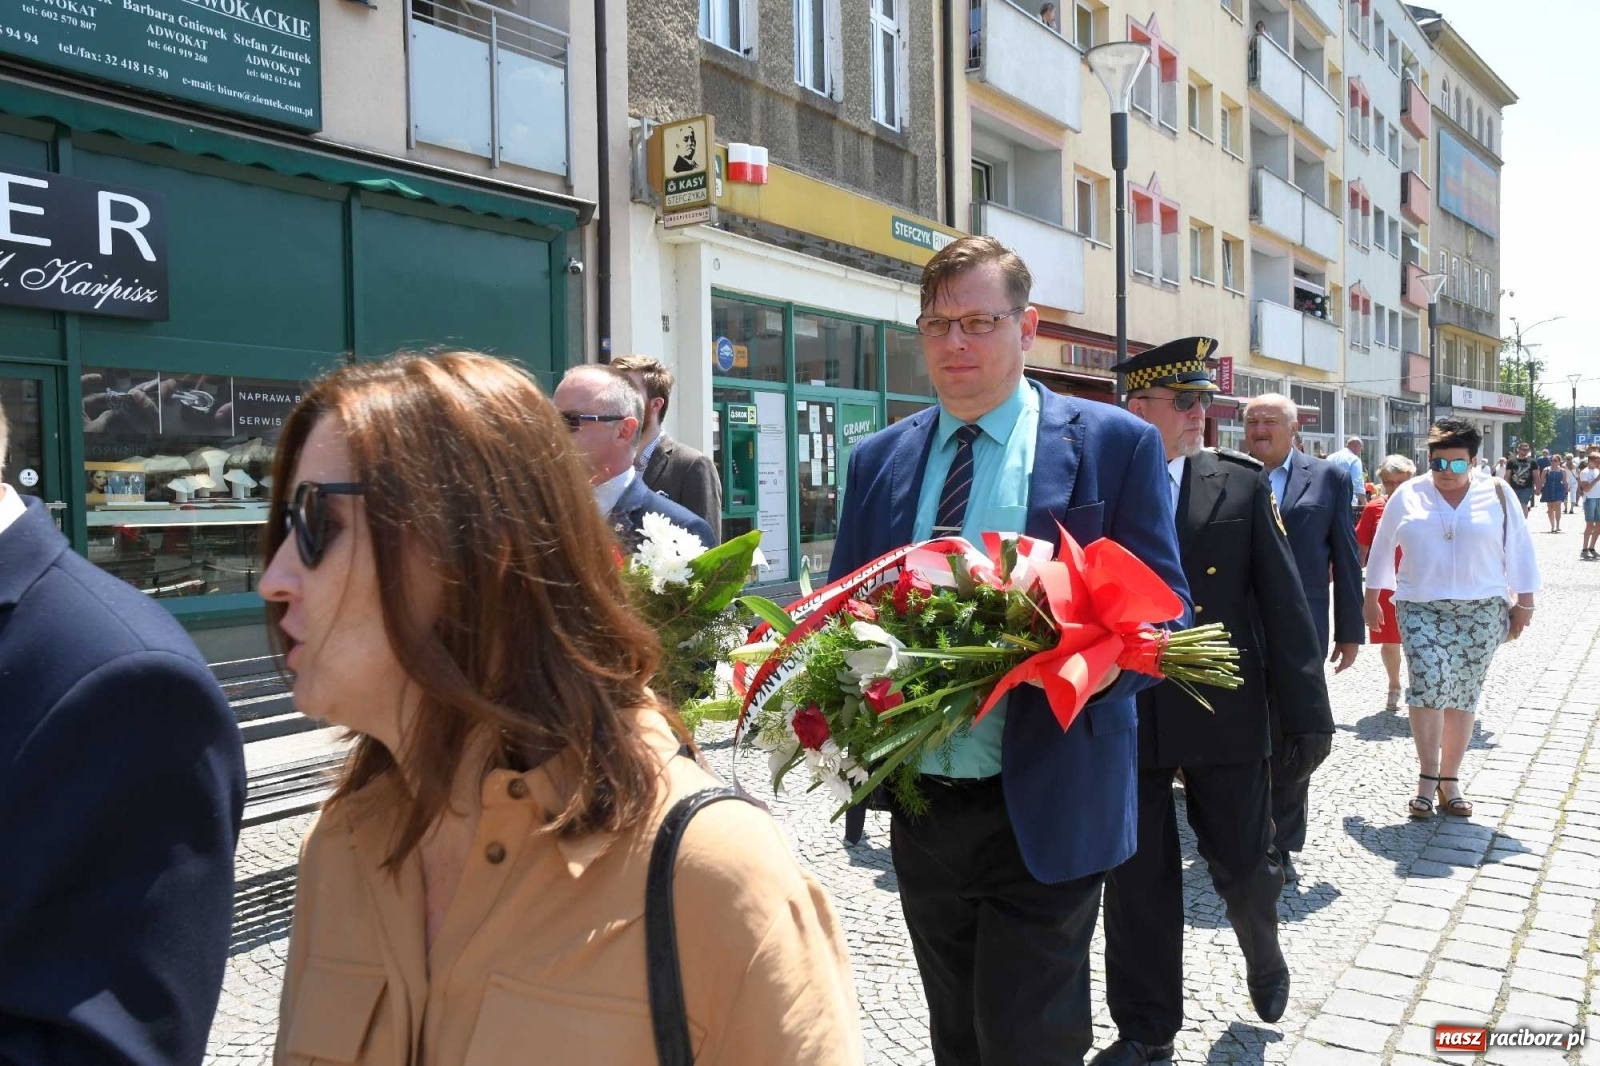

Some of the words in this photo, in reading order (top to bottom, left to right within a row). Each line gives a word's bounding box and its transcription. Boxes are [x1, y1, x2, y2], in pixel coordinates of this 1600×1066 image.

[22, 4, 38, 15] tel:
[41, 9, 58, 21] 602
[60, 14, 78, 27] 570
[80, 20, 97, 31] 807
[122, 0, 174, 23] Barbara
[178, 15, 227, 40] Gniewek
[190, 0, 311, 38] WOKACKIE
[5, 26, 21, 40] 94
[24, 31, 39, 45] 94
[146, 23, 208, 51] ADWOKAT
[58, 42, 102, 62] tel./fax:
[104, 53, 119, 66] 32
[120, 59, 140, 72] 418
[143, 64, 155, 75] 15
[156, 68, 169, 79] 30
[147, 39, 161, 50] tel:
[162, 43, 177, 54] 661
[178, 47, 193, 58] 919
[194, 52, 209, 64] 268
[233, 33, 268, 52] Stefan
[271, 44, 311, 64] Zientek
[245, 54, 301, 77] ADWOKAT
[246, 68, 259, 78] tel:
[260, 73, 273, 82] 602
[274, 76, 287, 86] 612
[182, 77, 216, 93] e-mail:
[217, 84, 314, 118] biuro@zientek.com.pl
[679, 175, 704, 190] KASY
[667, 191, 706, 205] STEFCZYKA
[895, 221, 931, 245] STEFCZYK
[20, 258, 158, 309] Karpisz
[239, 391, 291, 403] NAPRAWA
[239, 416, 282, 426] SERWIS
[843, 420, 870, 436] GRAMY
